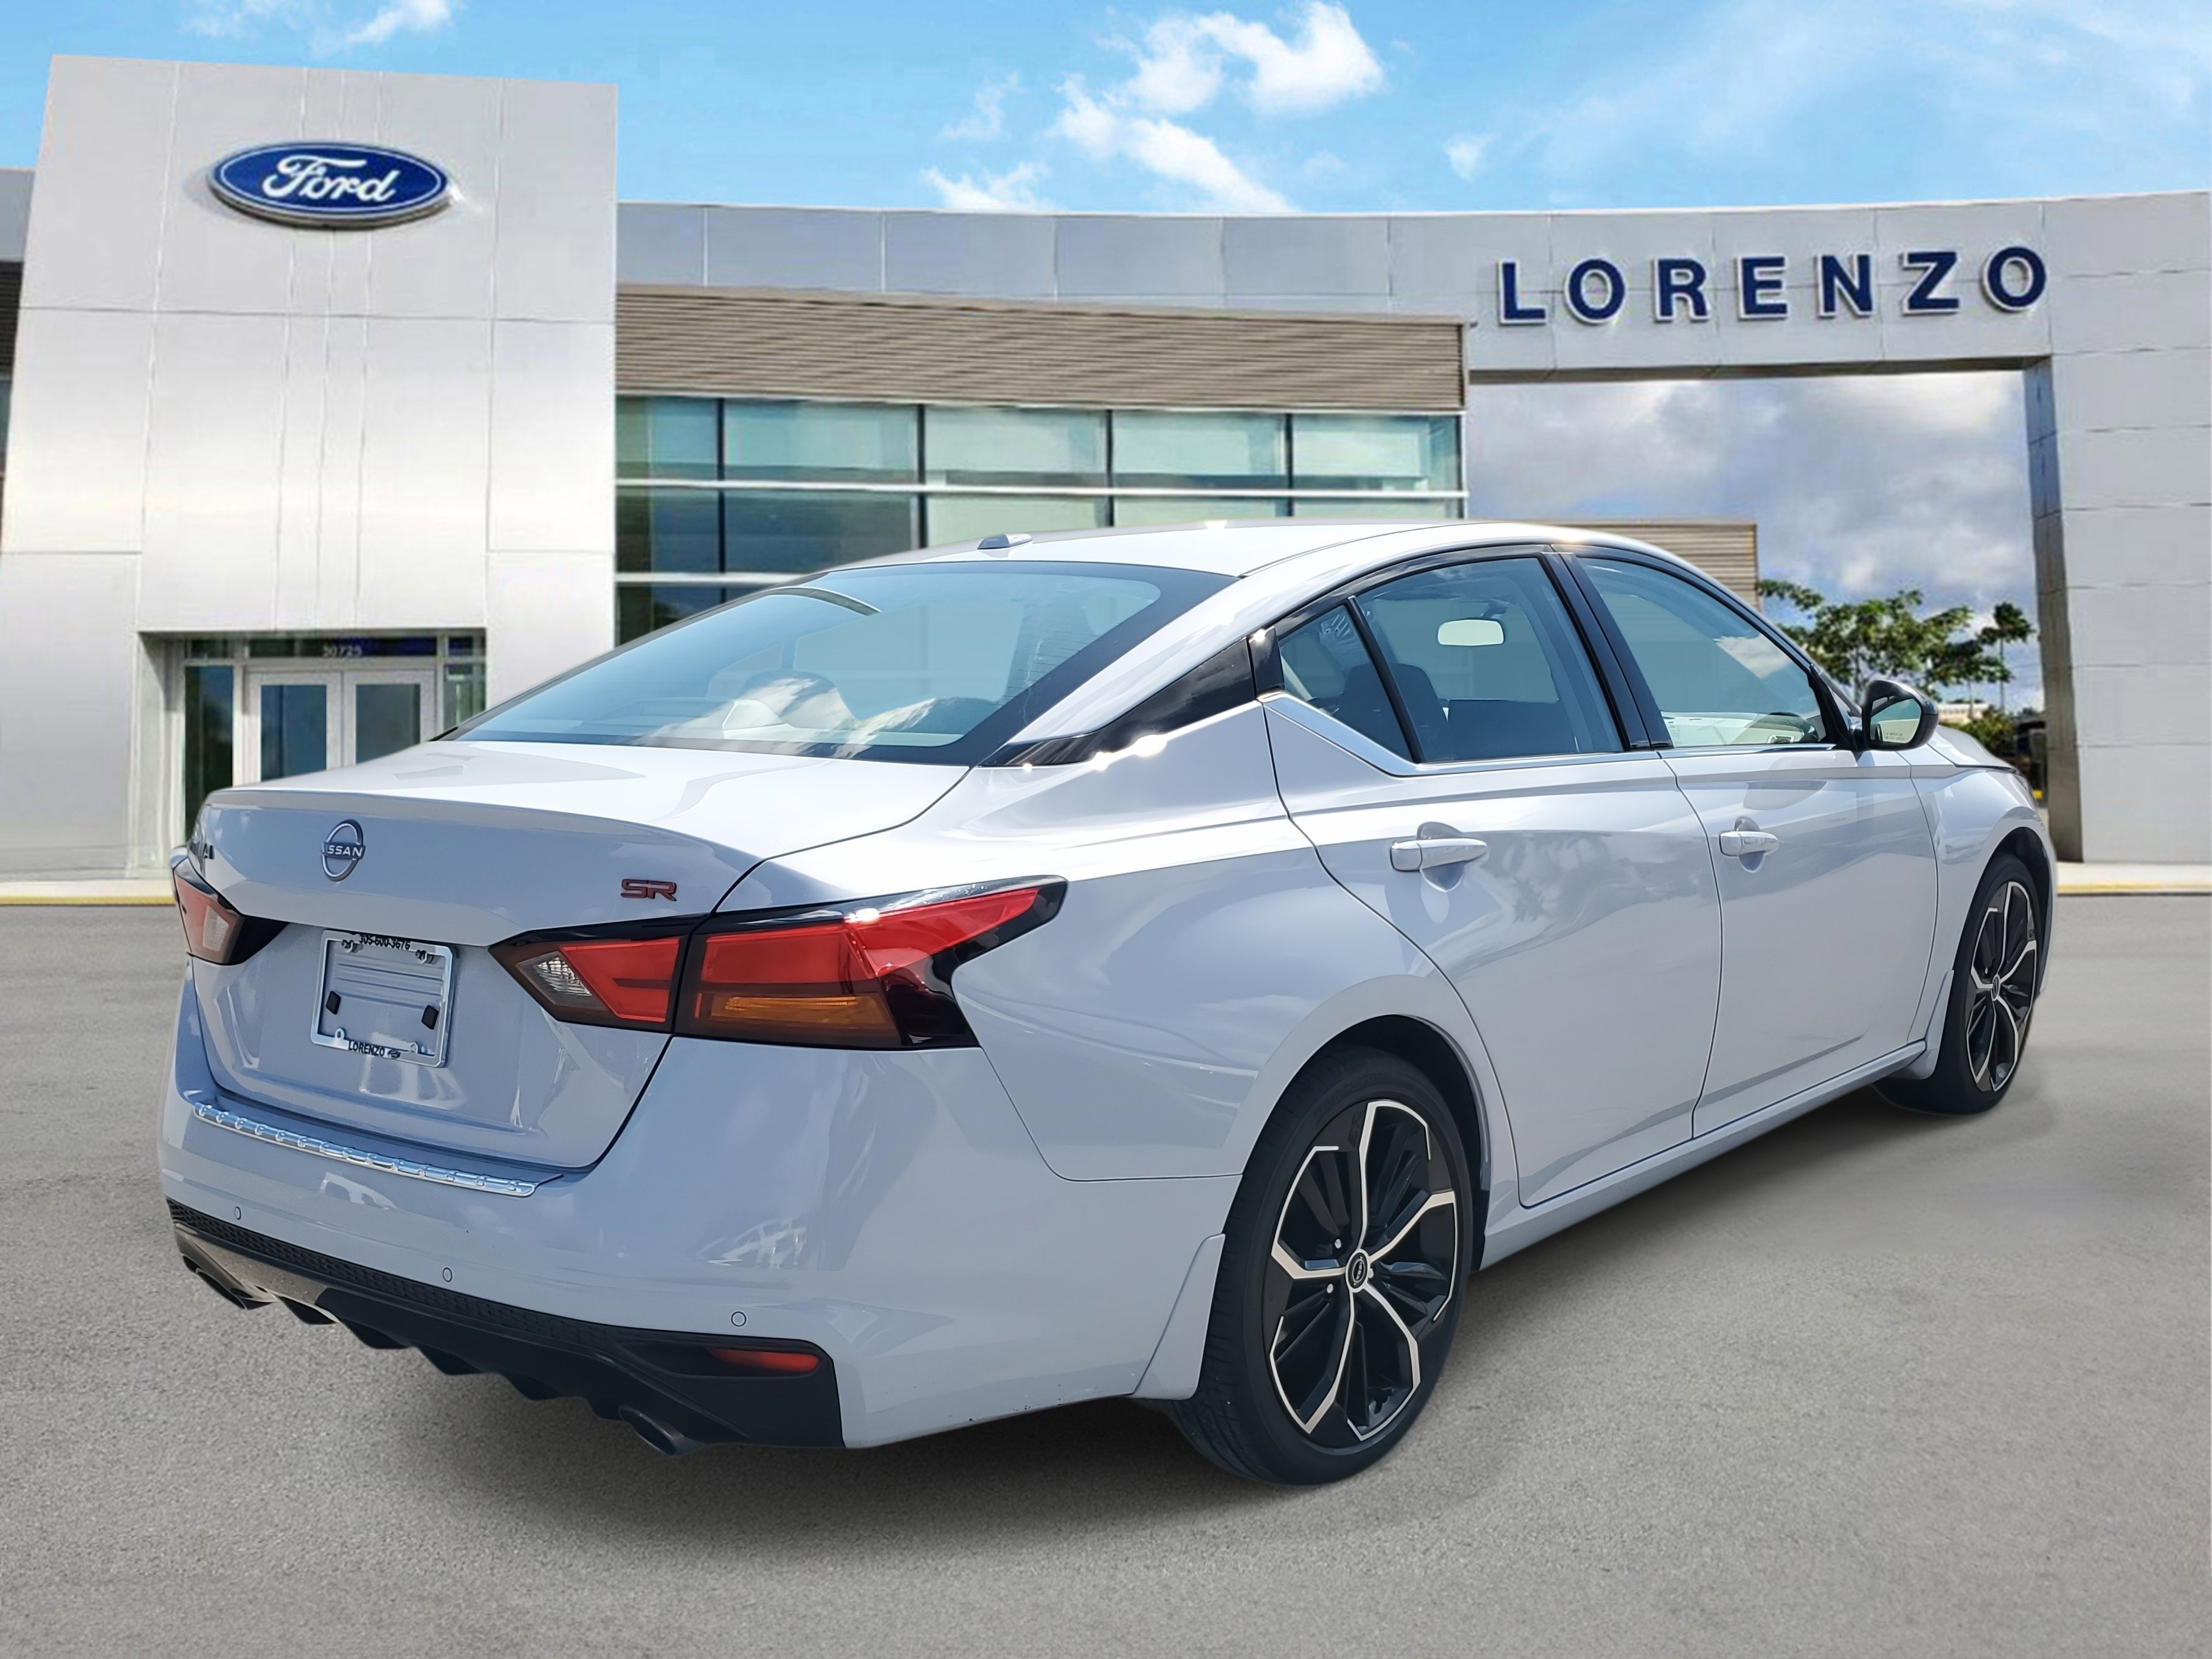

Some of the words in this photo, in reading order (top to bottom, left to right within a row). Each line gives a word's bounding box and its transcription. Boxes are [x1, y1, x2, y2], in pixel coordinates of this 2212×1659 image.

[262, 154, 400, 202] Ford
[1498, 246, 2048, 325] LORENZO
[620, 879, 677, 901] SR
[348, 1041, 385, 1057] LORENZO
